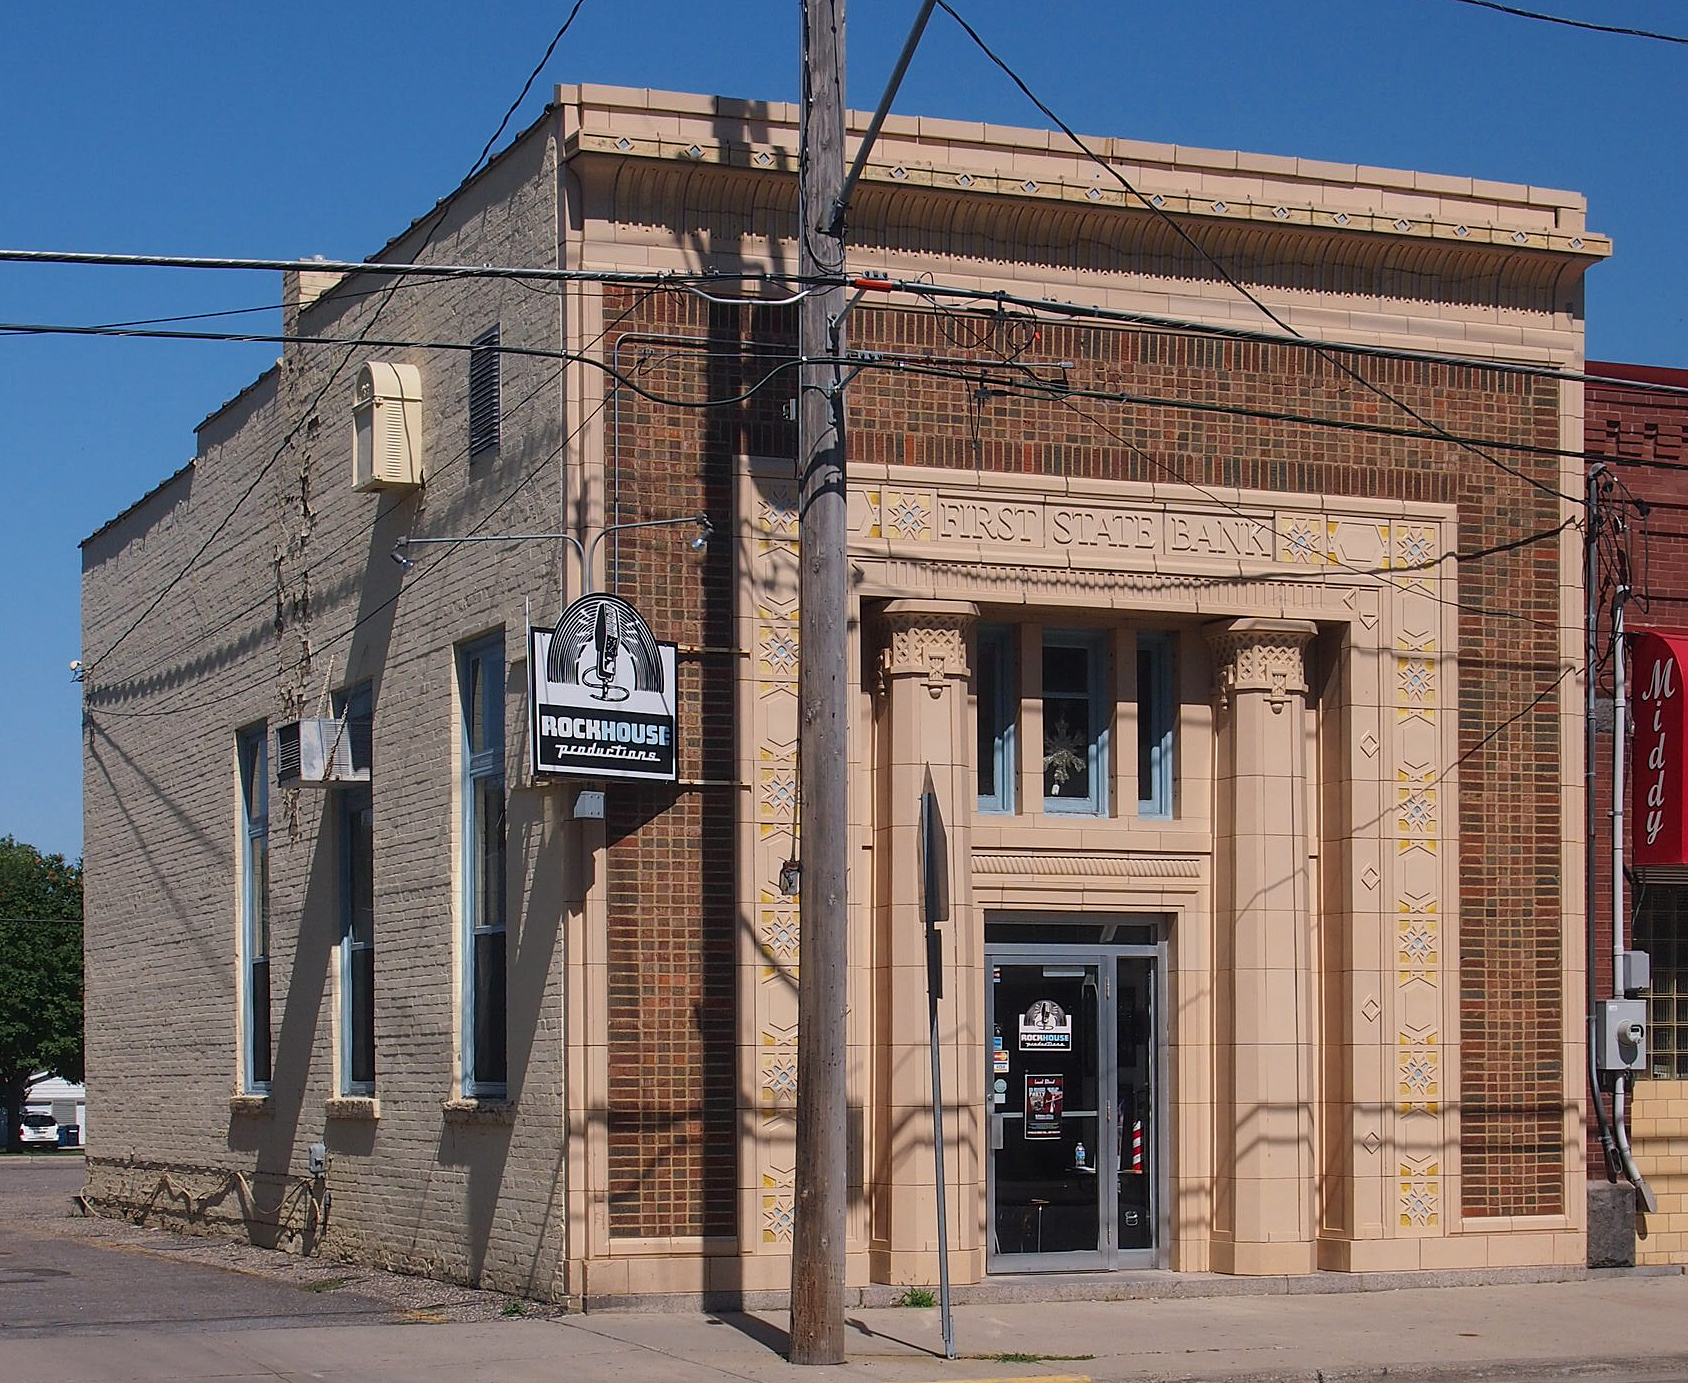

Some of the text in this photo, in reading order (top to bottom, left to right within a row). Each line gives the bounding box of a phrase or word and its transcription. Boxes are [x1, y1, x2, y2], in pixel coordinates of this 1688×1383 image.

[941, 502, 1272, 558] FIRST STATE BANK
[541, 715, 671, 746] ROCKHOUSE
[1641, 657, 1676, 845] Middy
[554, 742, 662, 763] productions
